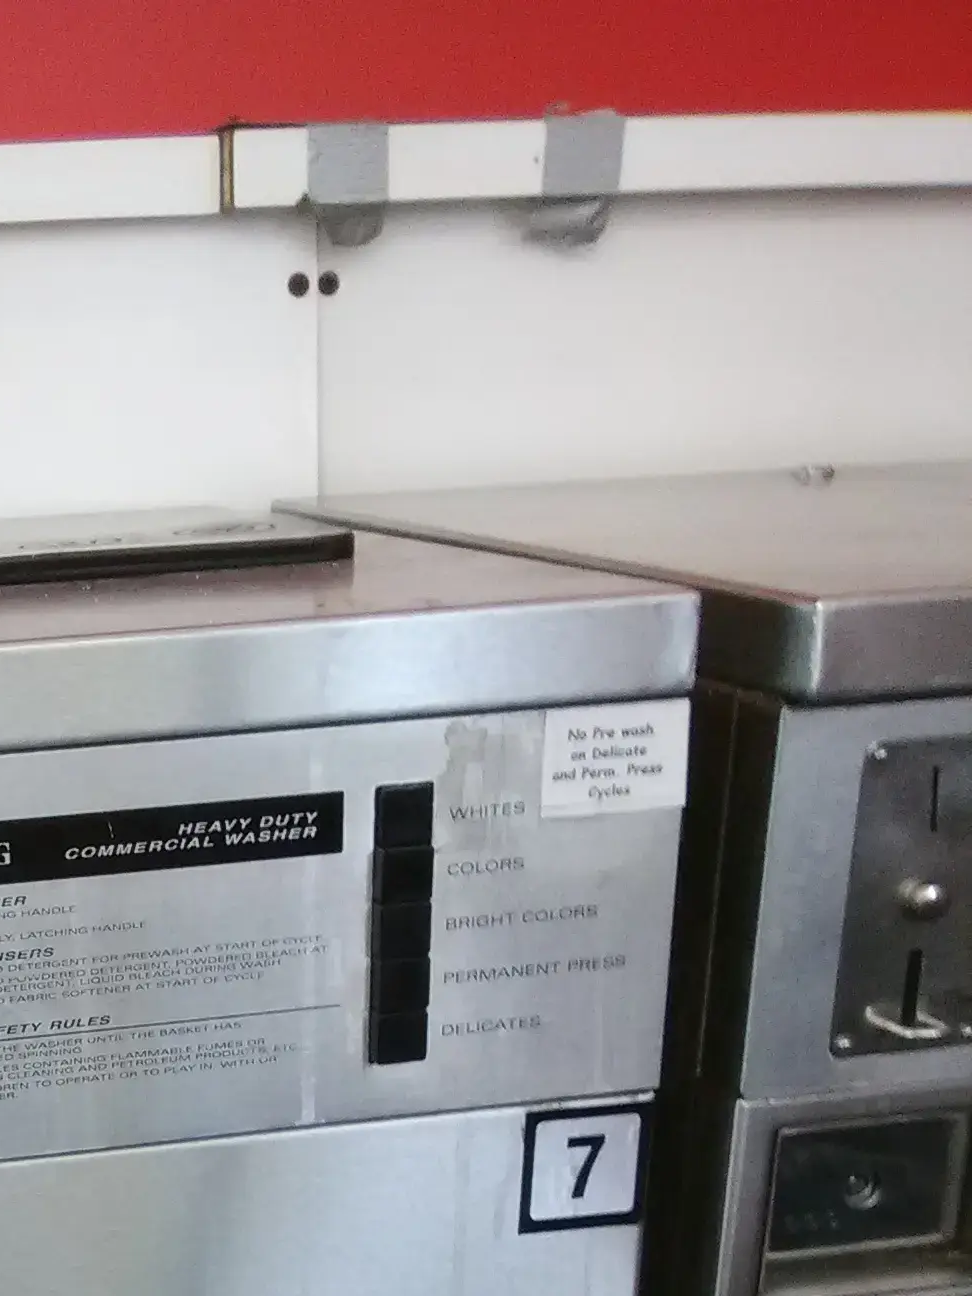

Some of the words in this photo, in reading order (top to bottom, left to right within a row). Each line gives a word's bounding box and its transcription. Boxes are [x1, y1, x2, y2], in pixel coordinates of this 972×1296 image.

[568, 728, 586, 741] No
[592, 725, 616, 739] Pre
[621, 722, 654, 737] wash
[571, 751, 586, 761] on
[592, 745, 648, 759] Delicate
[552, 768, 576, 781] and
[626, 763, 663, 775] Press
[588, 783, 630, 800] Cycles
[178, 817, 253, 836] HEAVY
[260, 811, 319, 829] DUTY
[450, 800, 526, 821] WHITES
[65, 833, 215, 861] COMMERCIAL
[225, 825, 319, 847] WASHER
[447, 857, 525, 876] COLORS
[21, 905, 76, 917] HANDLE
[445, 913, 514, 931] BRIGHT
[522, 904, 599, 924] COLORS
[19, 926, 89, 942] LATCHING
[92, 921, 146, 933] HANDLE
[7, 957, 89, 975] DETERGENT
[92, 953, 119, 963] FOR
[123, 946, 189, 961] PREWASH
[193, 944, 211, 954] AT
[215, 939, 256, 951] START
[262, 937, 278, 947] OF
[7, 968, 87, 985] POWDERED
[175, 952, 251, 967] POWDERED
[255, 947, 308, 959] BLEACH
[310, 944, 328, 954] AT
[442, 961, 561, 984] PERMANENT
[567, 954, 627, 972] PRESS
[80, 975, 125, 986] LIQUID
[129, 969, 181, 981] BLEACH
[185, 963, 237, 974] DURING
[239, 958, 282, 969] WASH
[9, 992, 57, 1004] FABRIC
[61, 984, 132, 999] SOFTENER
[135, 982, 152, 991] AT
[156, 977, 198, 989] START
[203, 976, 220, 985] OF
[50, 1015, 111, 1030] RULES
[441, 1015, 542, 1037] DELICATES
[24, 1038, 83, 1051] WASHER
[87, 1034, 124, 1044] UNTIL
[131, 1029, 155, 1040] THE
[160, 1024, 210, 1037] BASKET
[214, 1021, 242, 1030] HAS
[18, 1046, 82, 1060] SPINNING
[24, 1053, 106, 1071] CONTAINING
[110, 1045, 193, 1060] FLAMMABLE
[197, 1039, 244, 1051] FUMES
[247, 1037, 265, 1047] OR
[7, 1066, 74, 1081] CLEANING
[78, 1061, 108, 1073] AND
[111, 1054, 192, 1070] PETROLEUM
[36, 1079, 53, 1088] TO
[55, 1073, 115, 1086] OPERATE
[120, 1069, 138, 1079] OR
[144, 1068, 160, 1077] TO
[164, 1063, 194, 1075] PLAY
[220, 1059, 255, 1069] WITH
[259, 1055, 278, 1065] OR
[566, 1133, 607, 1199] 7
